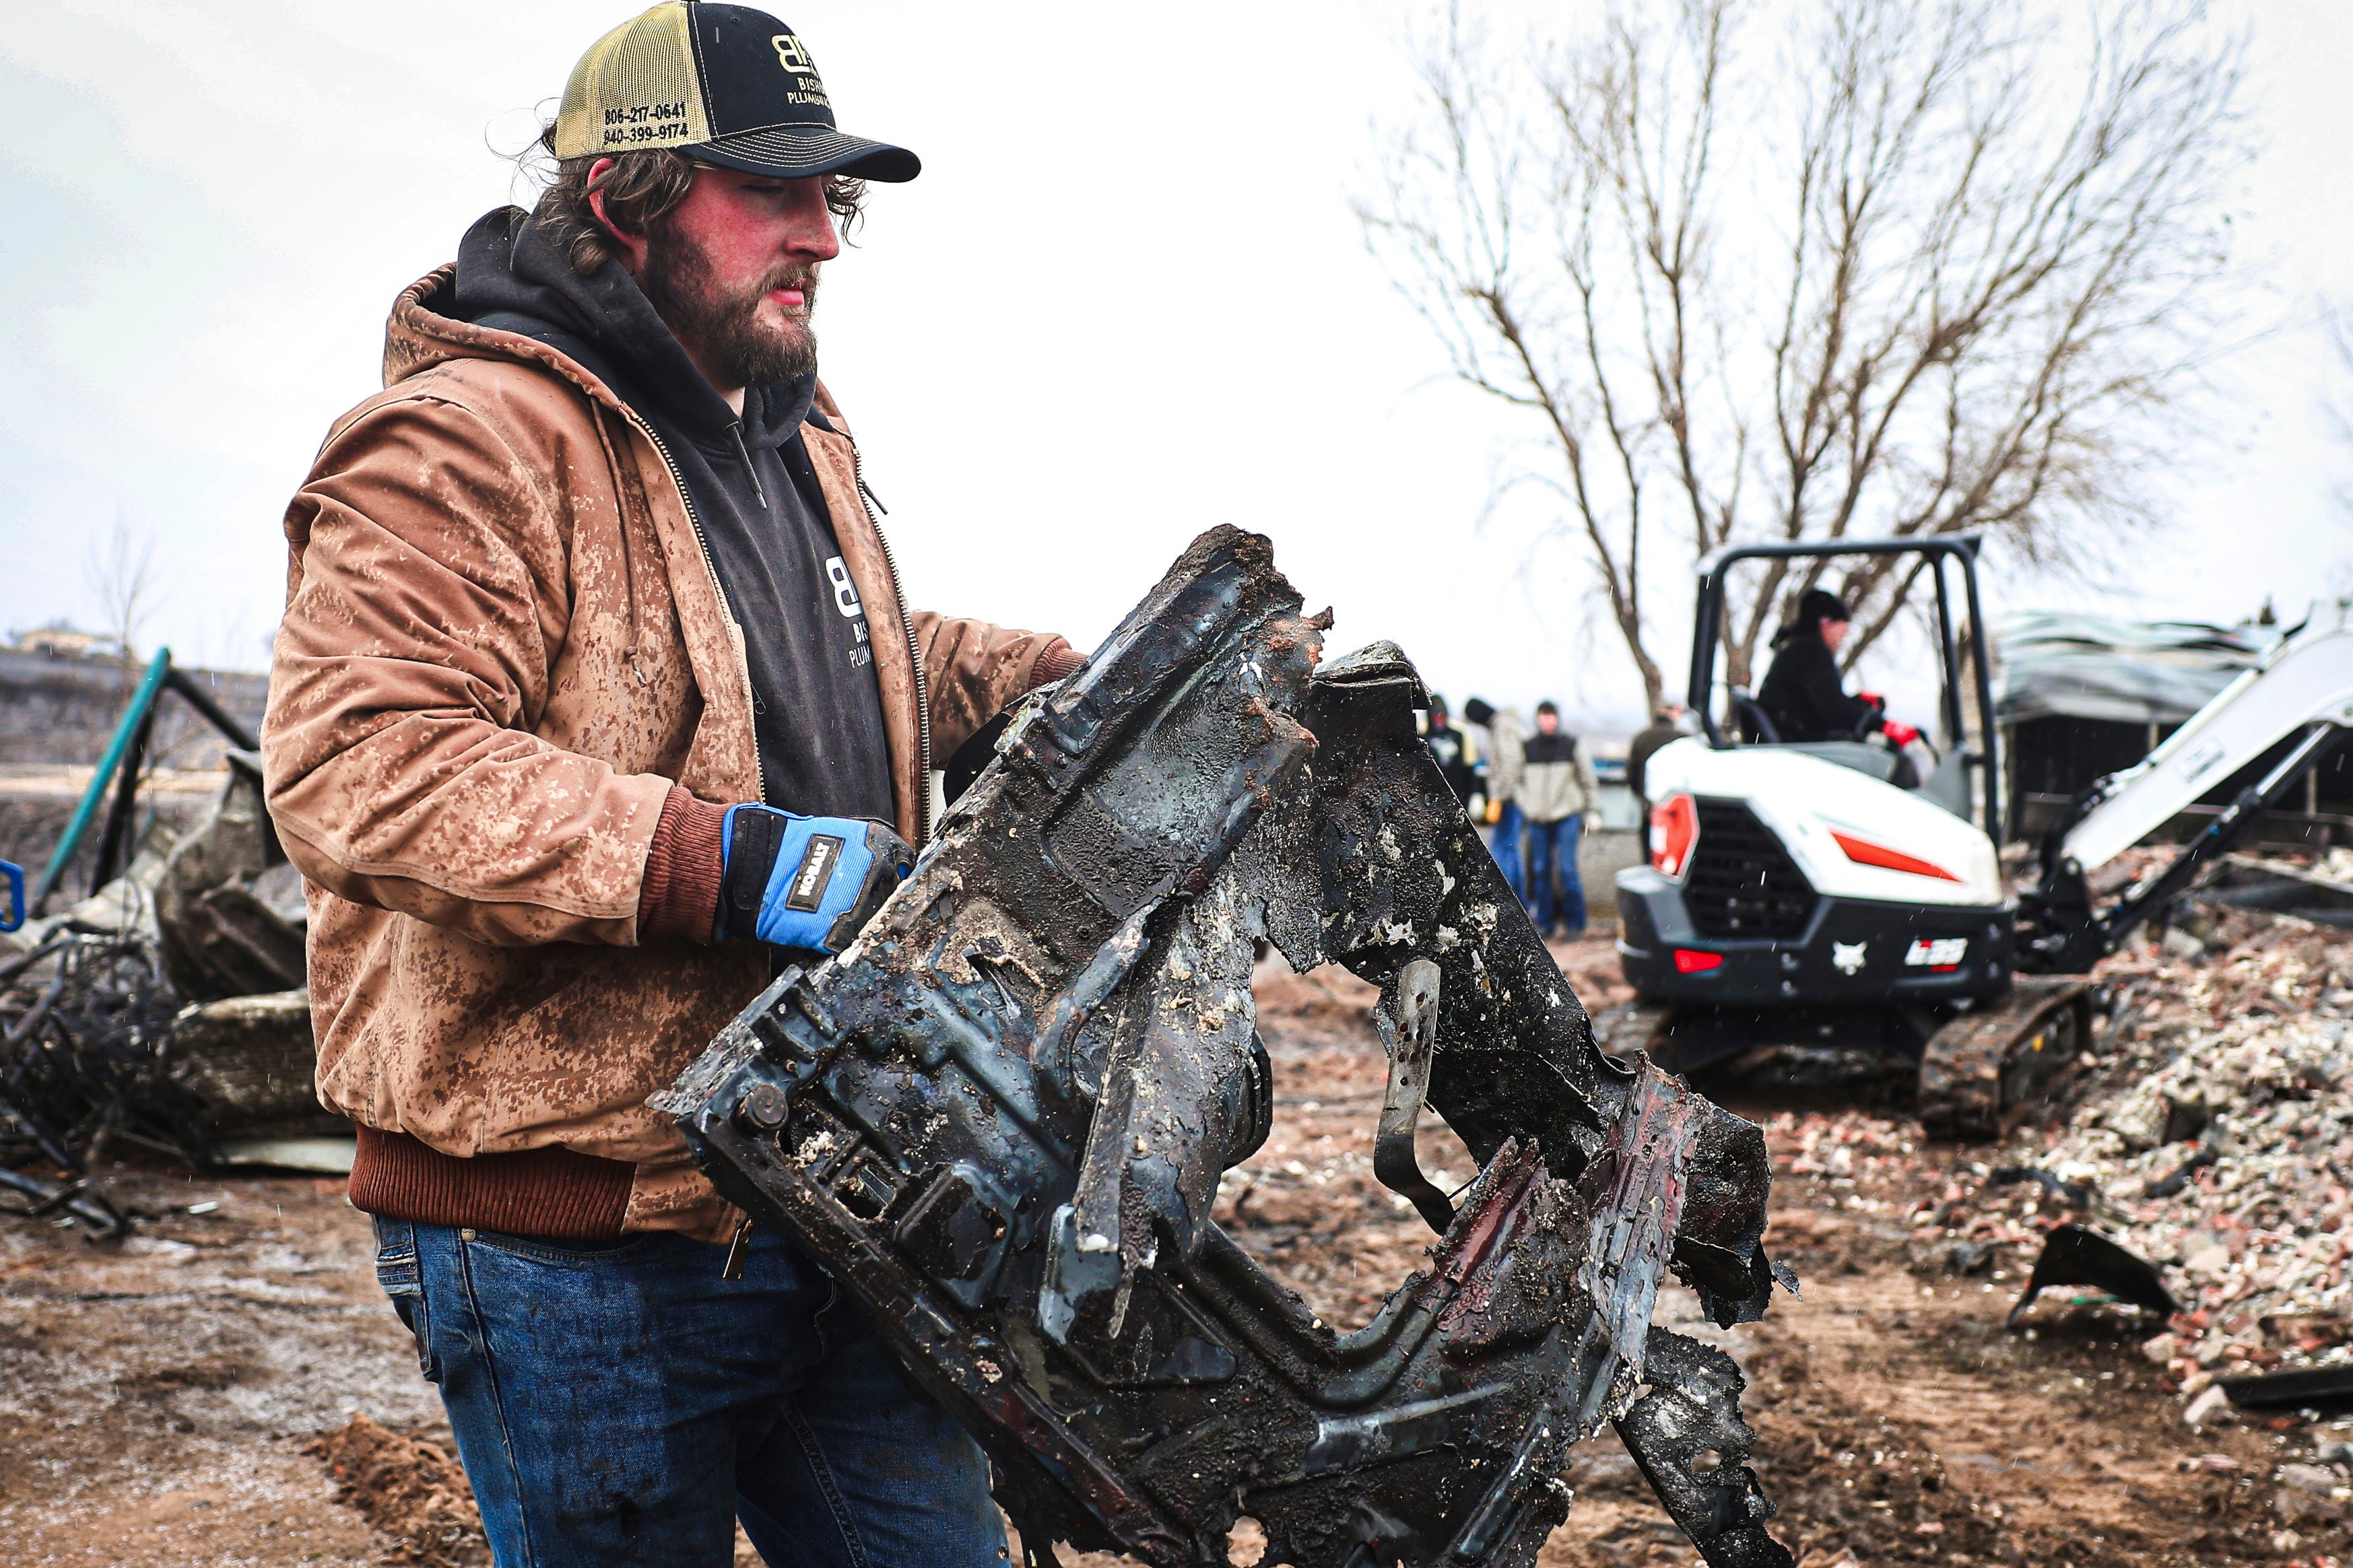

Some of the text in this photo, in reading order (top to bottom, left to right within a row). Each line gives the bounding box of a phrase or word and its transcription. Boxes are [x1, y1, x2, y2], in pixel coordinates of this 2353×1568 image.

[605, 101, 686, 125] 806-217-0641
[604, 123, 688, 145] 940-399-9174
[797, 842, 830, 896] KOBALT
